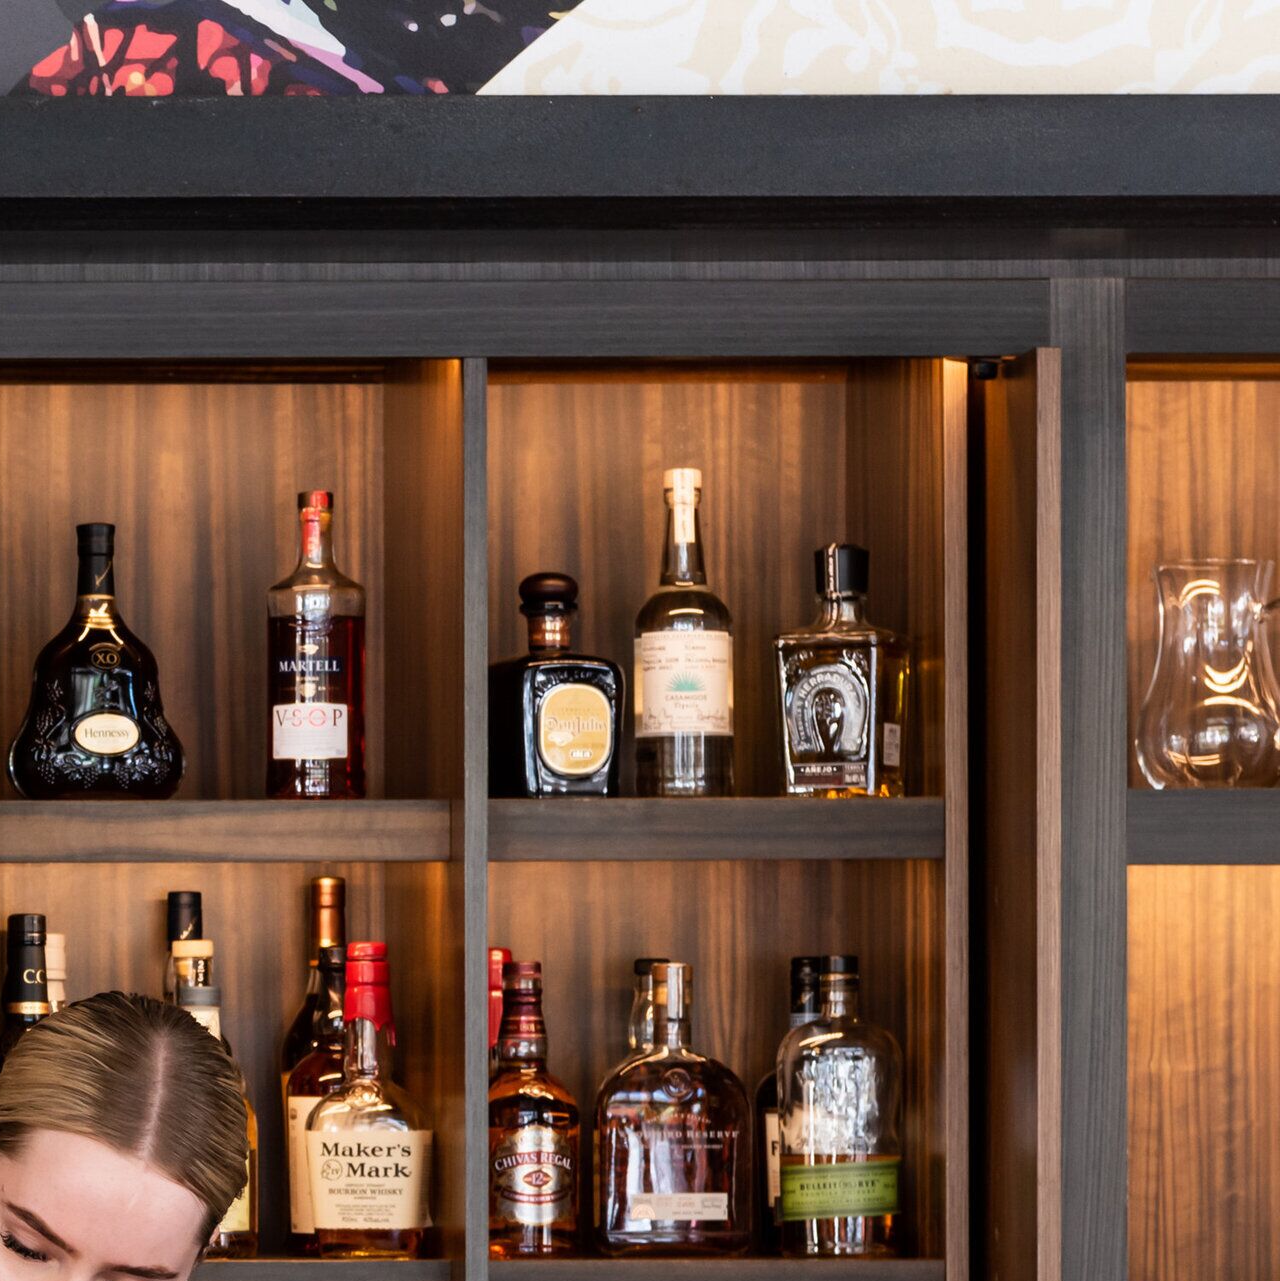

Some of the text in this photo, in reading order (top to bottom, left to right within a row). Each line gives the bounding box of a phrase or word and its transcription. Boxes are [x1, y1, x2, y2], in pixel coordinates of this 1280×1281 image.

[279, 660, 340, 672] MARTELL
[83, 727, 130, 740] Hennessy
[319, 1142, 412, 1157] Maker's
[494, 1152, 572, 1171] CHIVAS REGAL
[345, 1162, 412, 1178] Mark
[530, 1172, 544, 1185] 12
